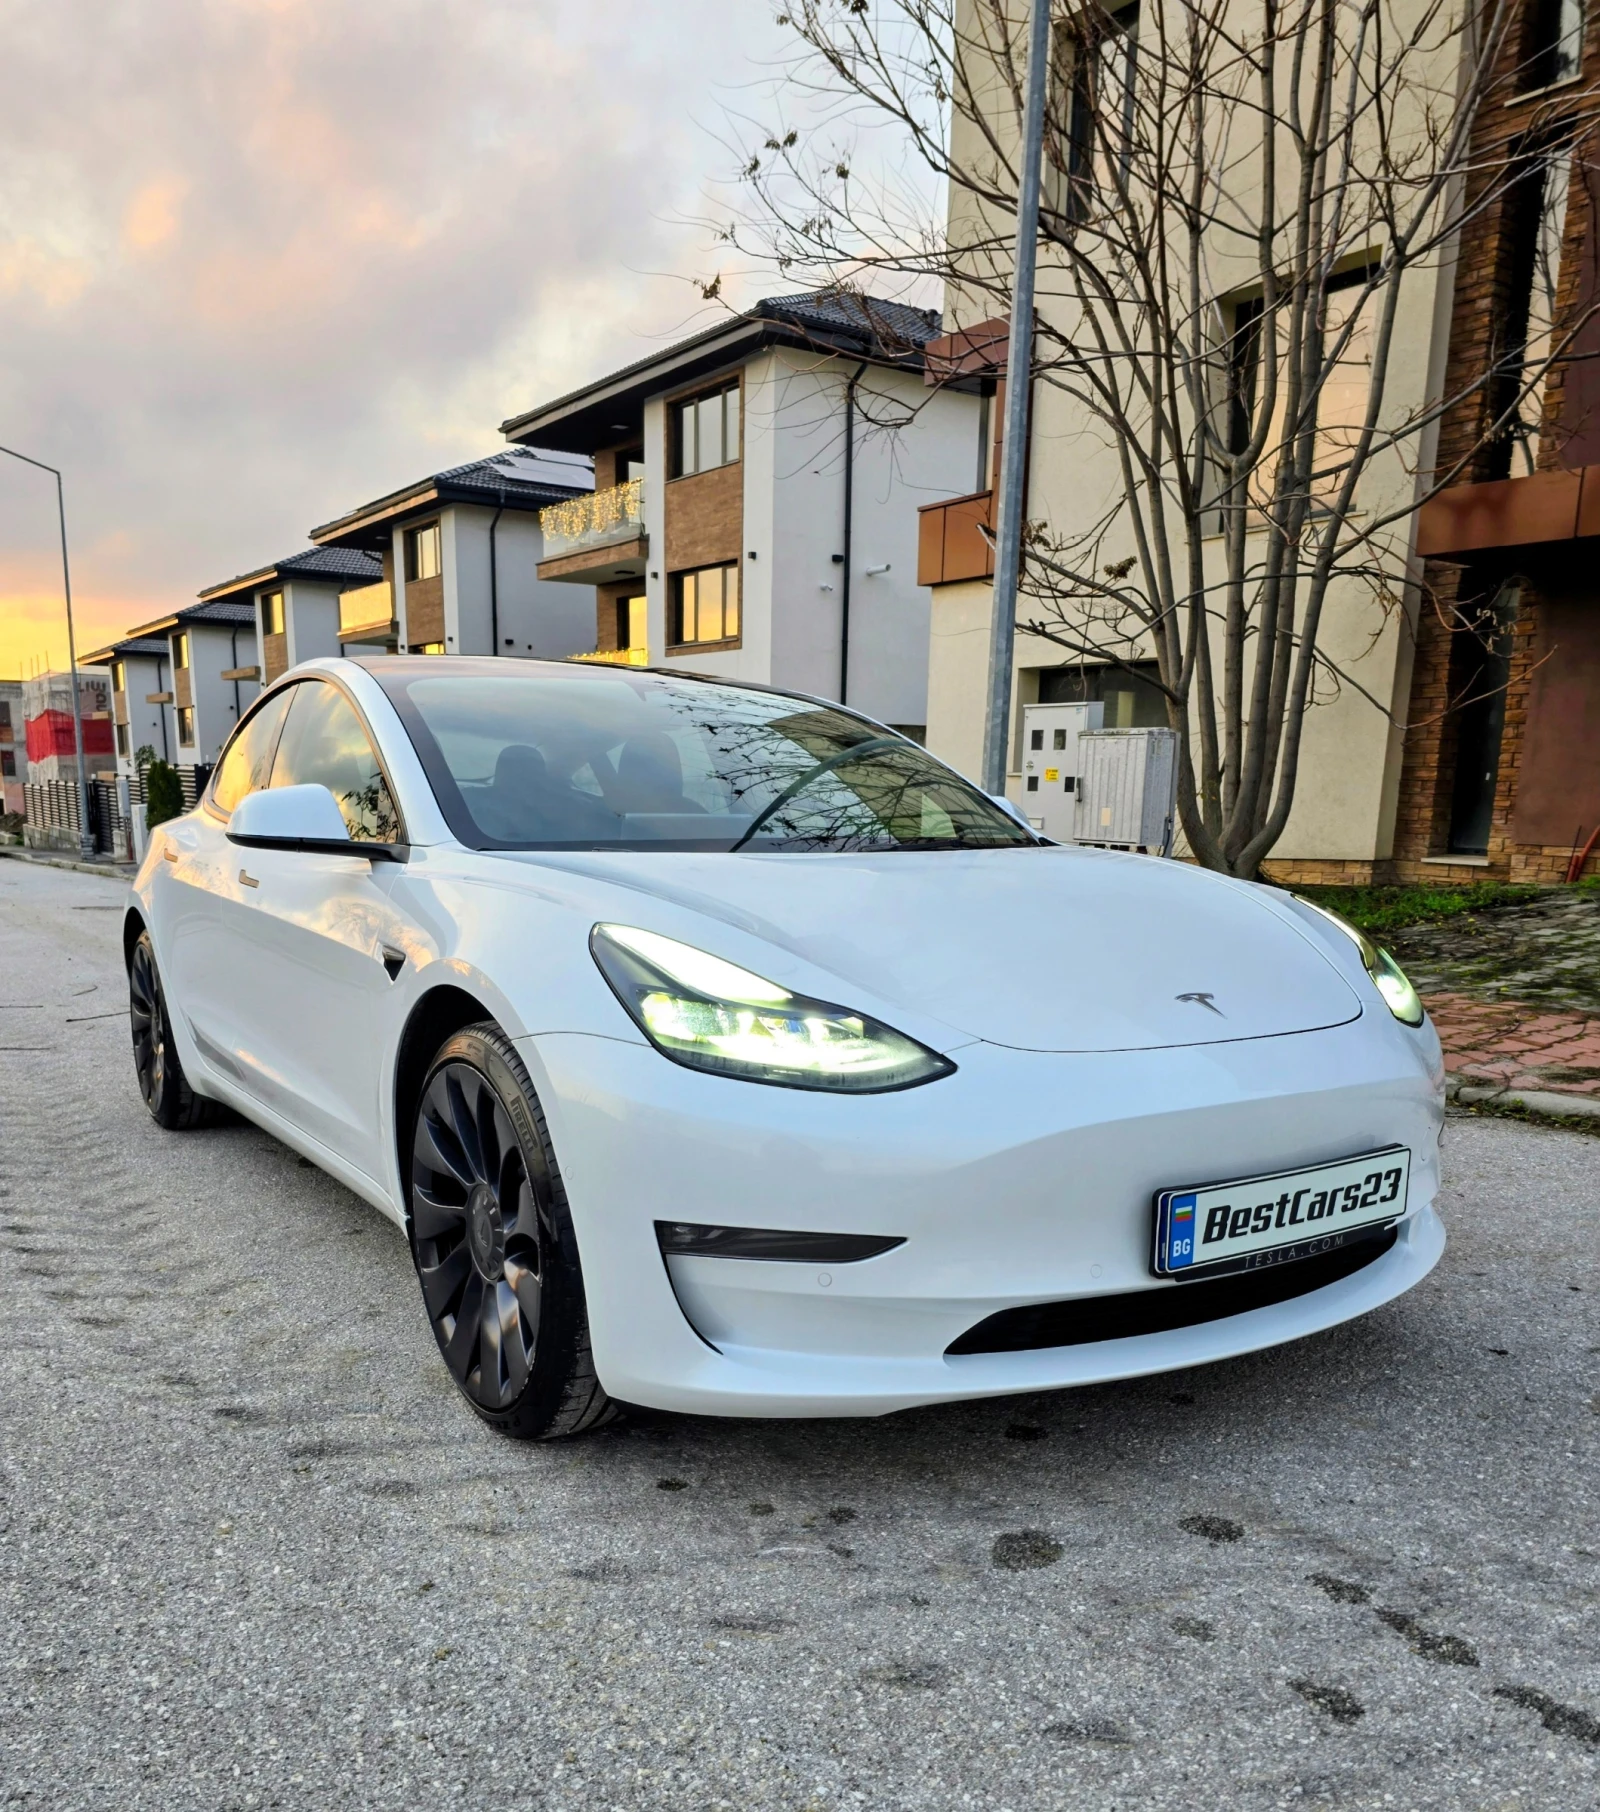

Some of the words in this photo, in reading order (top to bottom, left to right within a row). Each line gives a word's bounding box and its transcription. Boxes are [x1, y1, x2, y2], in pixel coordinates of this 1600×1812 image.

[1202, 1167, 1402, 1244] BestCars23
[1172, 1239, 1191, 1257] BG
[1245, 1235, 1345, 1268] TESLA.COM
